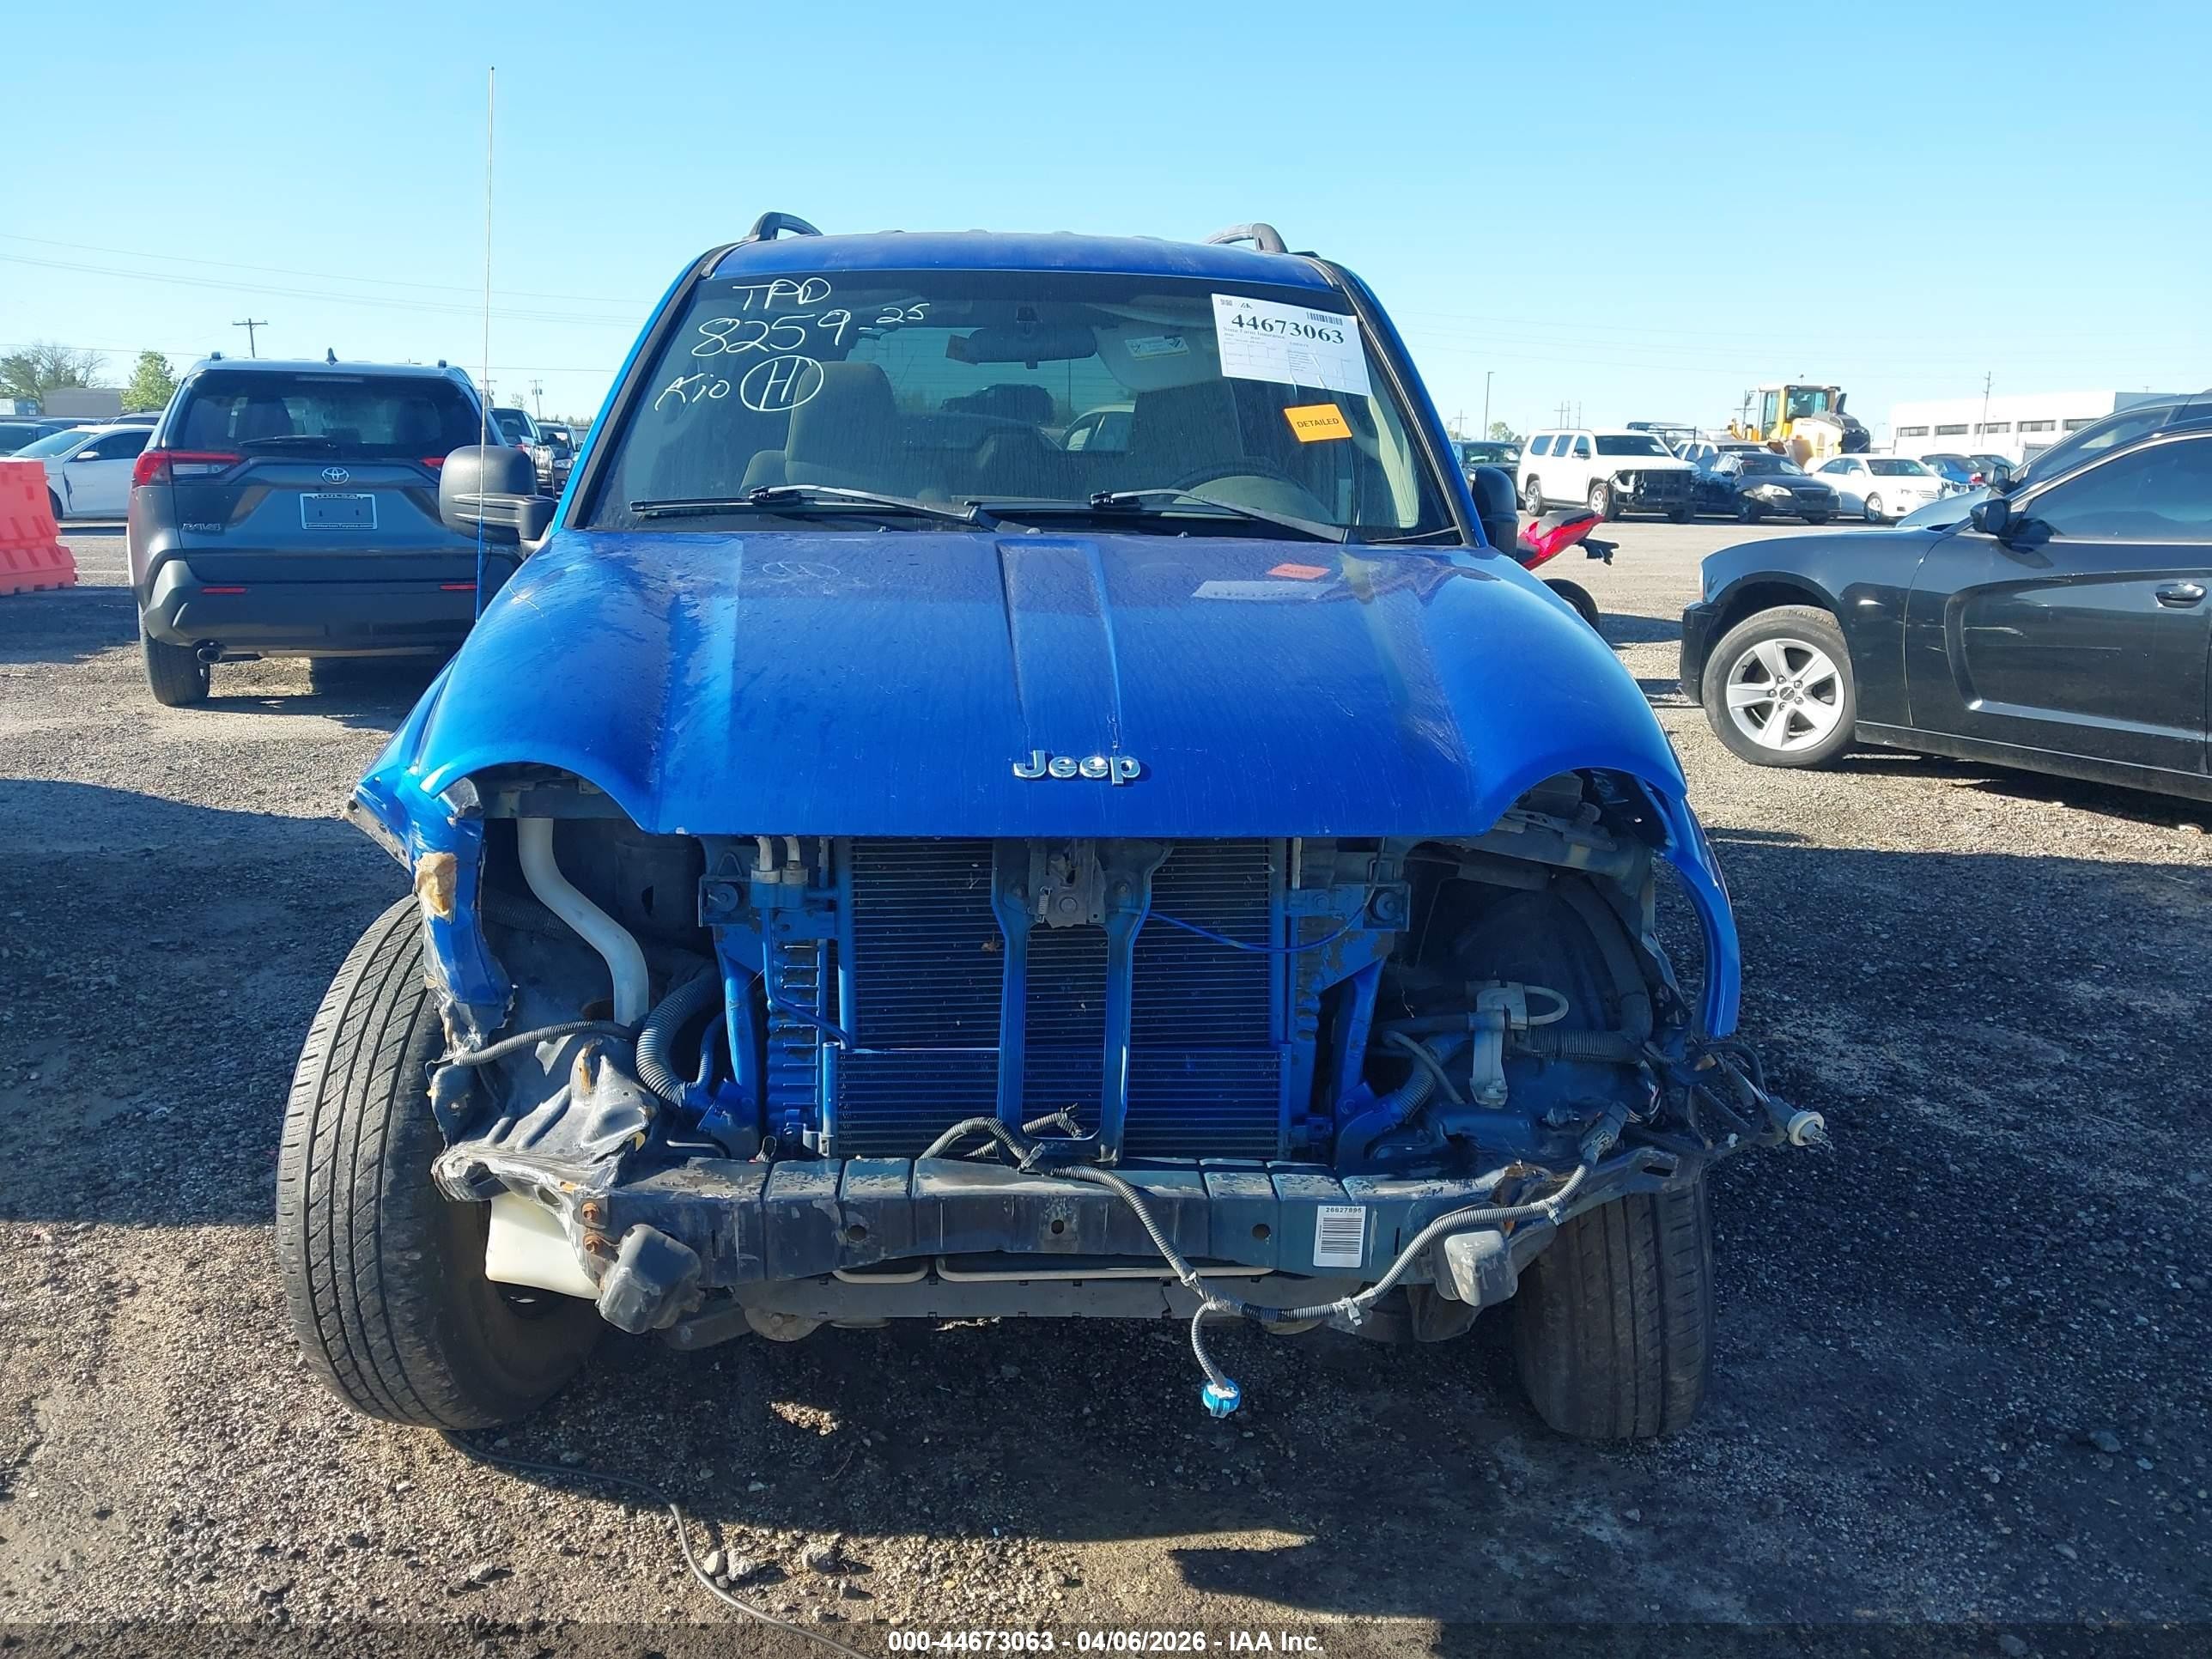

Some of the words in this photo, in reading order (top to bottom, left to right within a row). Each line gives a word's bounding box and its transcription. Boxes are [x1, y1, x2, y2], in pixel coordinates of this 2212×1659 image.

[732, 277, 831, 310] TPD
[1231, 313, 1345, 344] 44673063
[1296, 417, 1340, 428] DETAILED
[1012, 750, 1141, 786] Jeep
